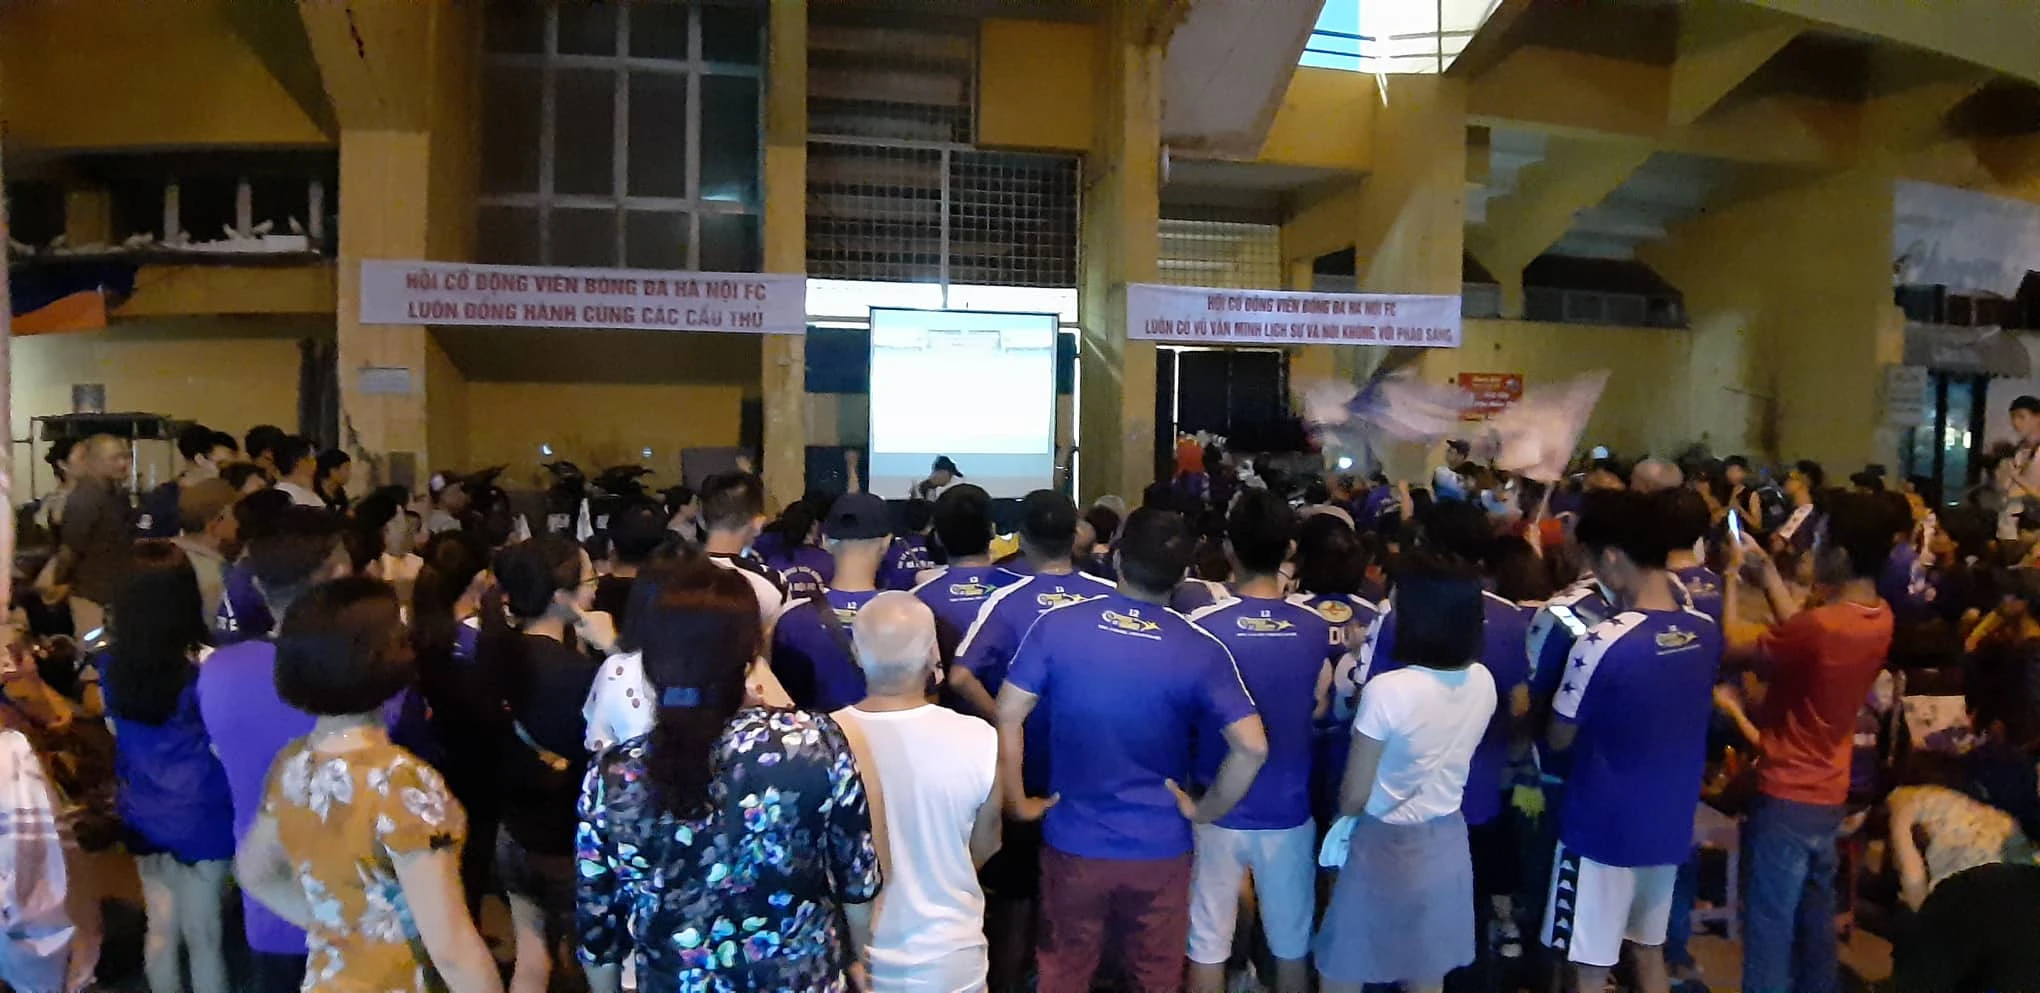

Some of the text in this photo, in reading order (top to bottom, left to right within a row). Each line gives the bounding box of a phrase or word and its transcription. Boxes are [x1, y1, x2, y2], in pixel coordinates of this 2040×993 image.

[534, 274, 578, 293] VIÊN
[744, 283, 767, 300] FC
[642, 304, 679, 325] CÁC
[729, 305, 763, 328] THỦ
[1384, 302, 1396, 316] FC
